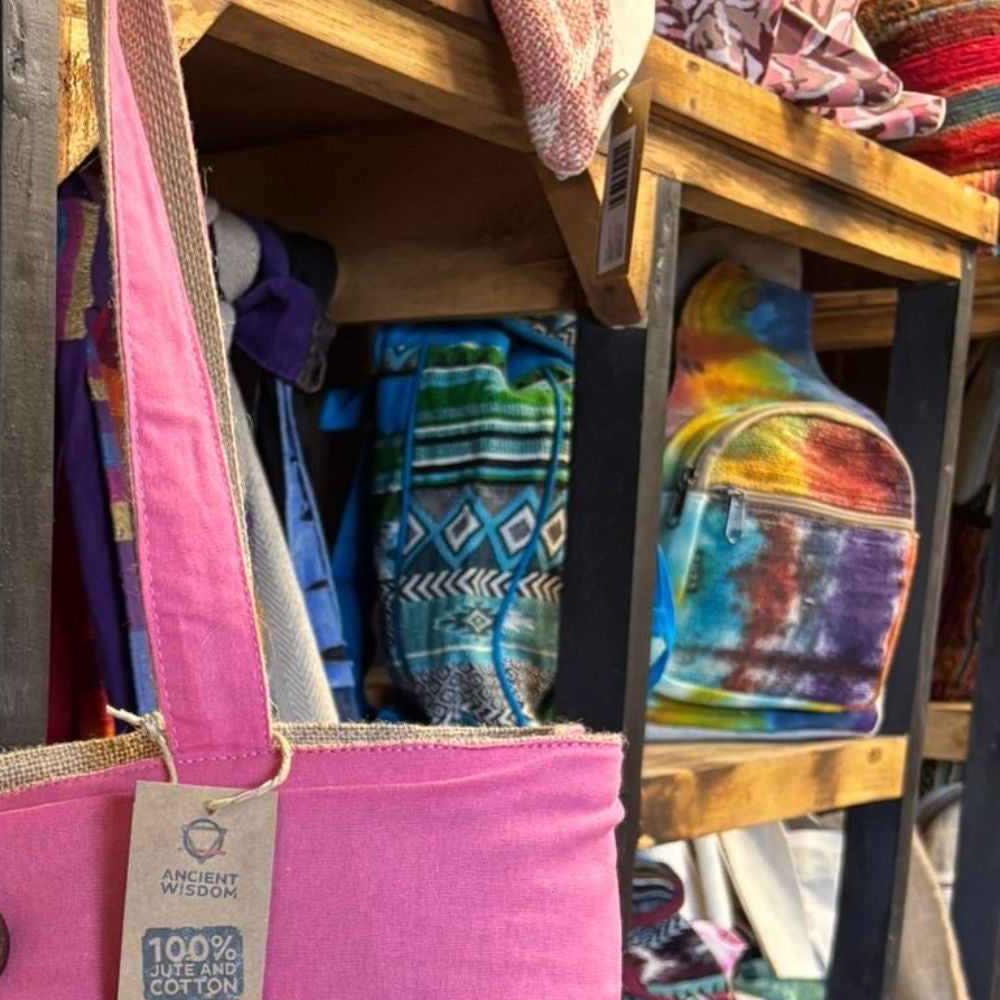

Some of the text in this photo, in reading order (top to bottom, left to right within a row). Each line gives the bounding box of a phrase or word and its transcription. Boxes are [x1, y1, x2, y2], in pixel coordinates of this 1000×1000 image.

[161, 869, 238, 885] ANCIENT
[160, 882, 238, 899] WISDOM
[148, 935, 237, 962] 100%
[150, 962, 237, 978] JUTE AND
[150, 977, 238, 996] COTTON
